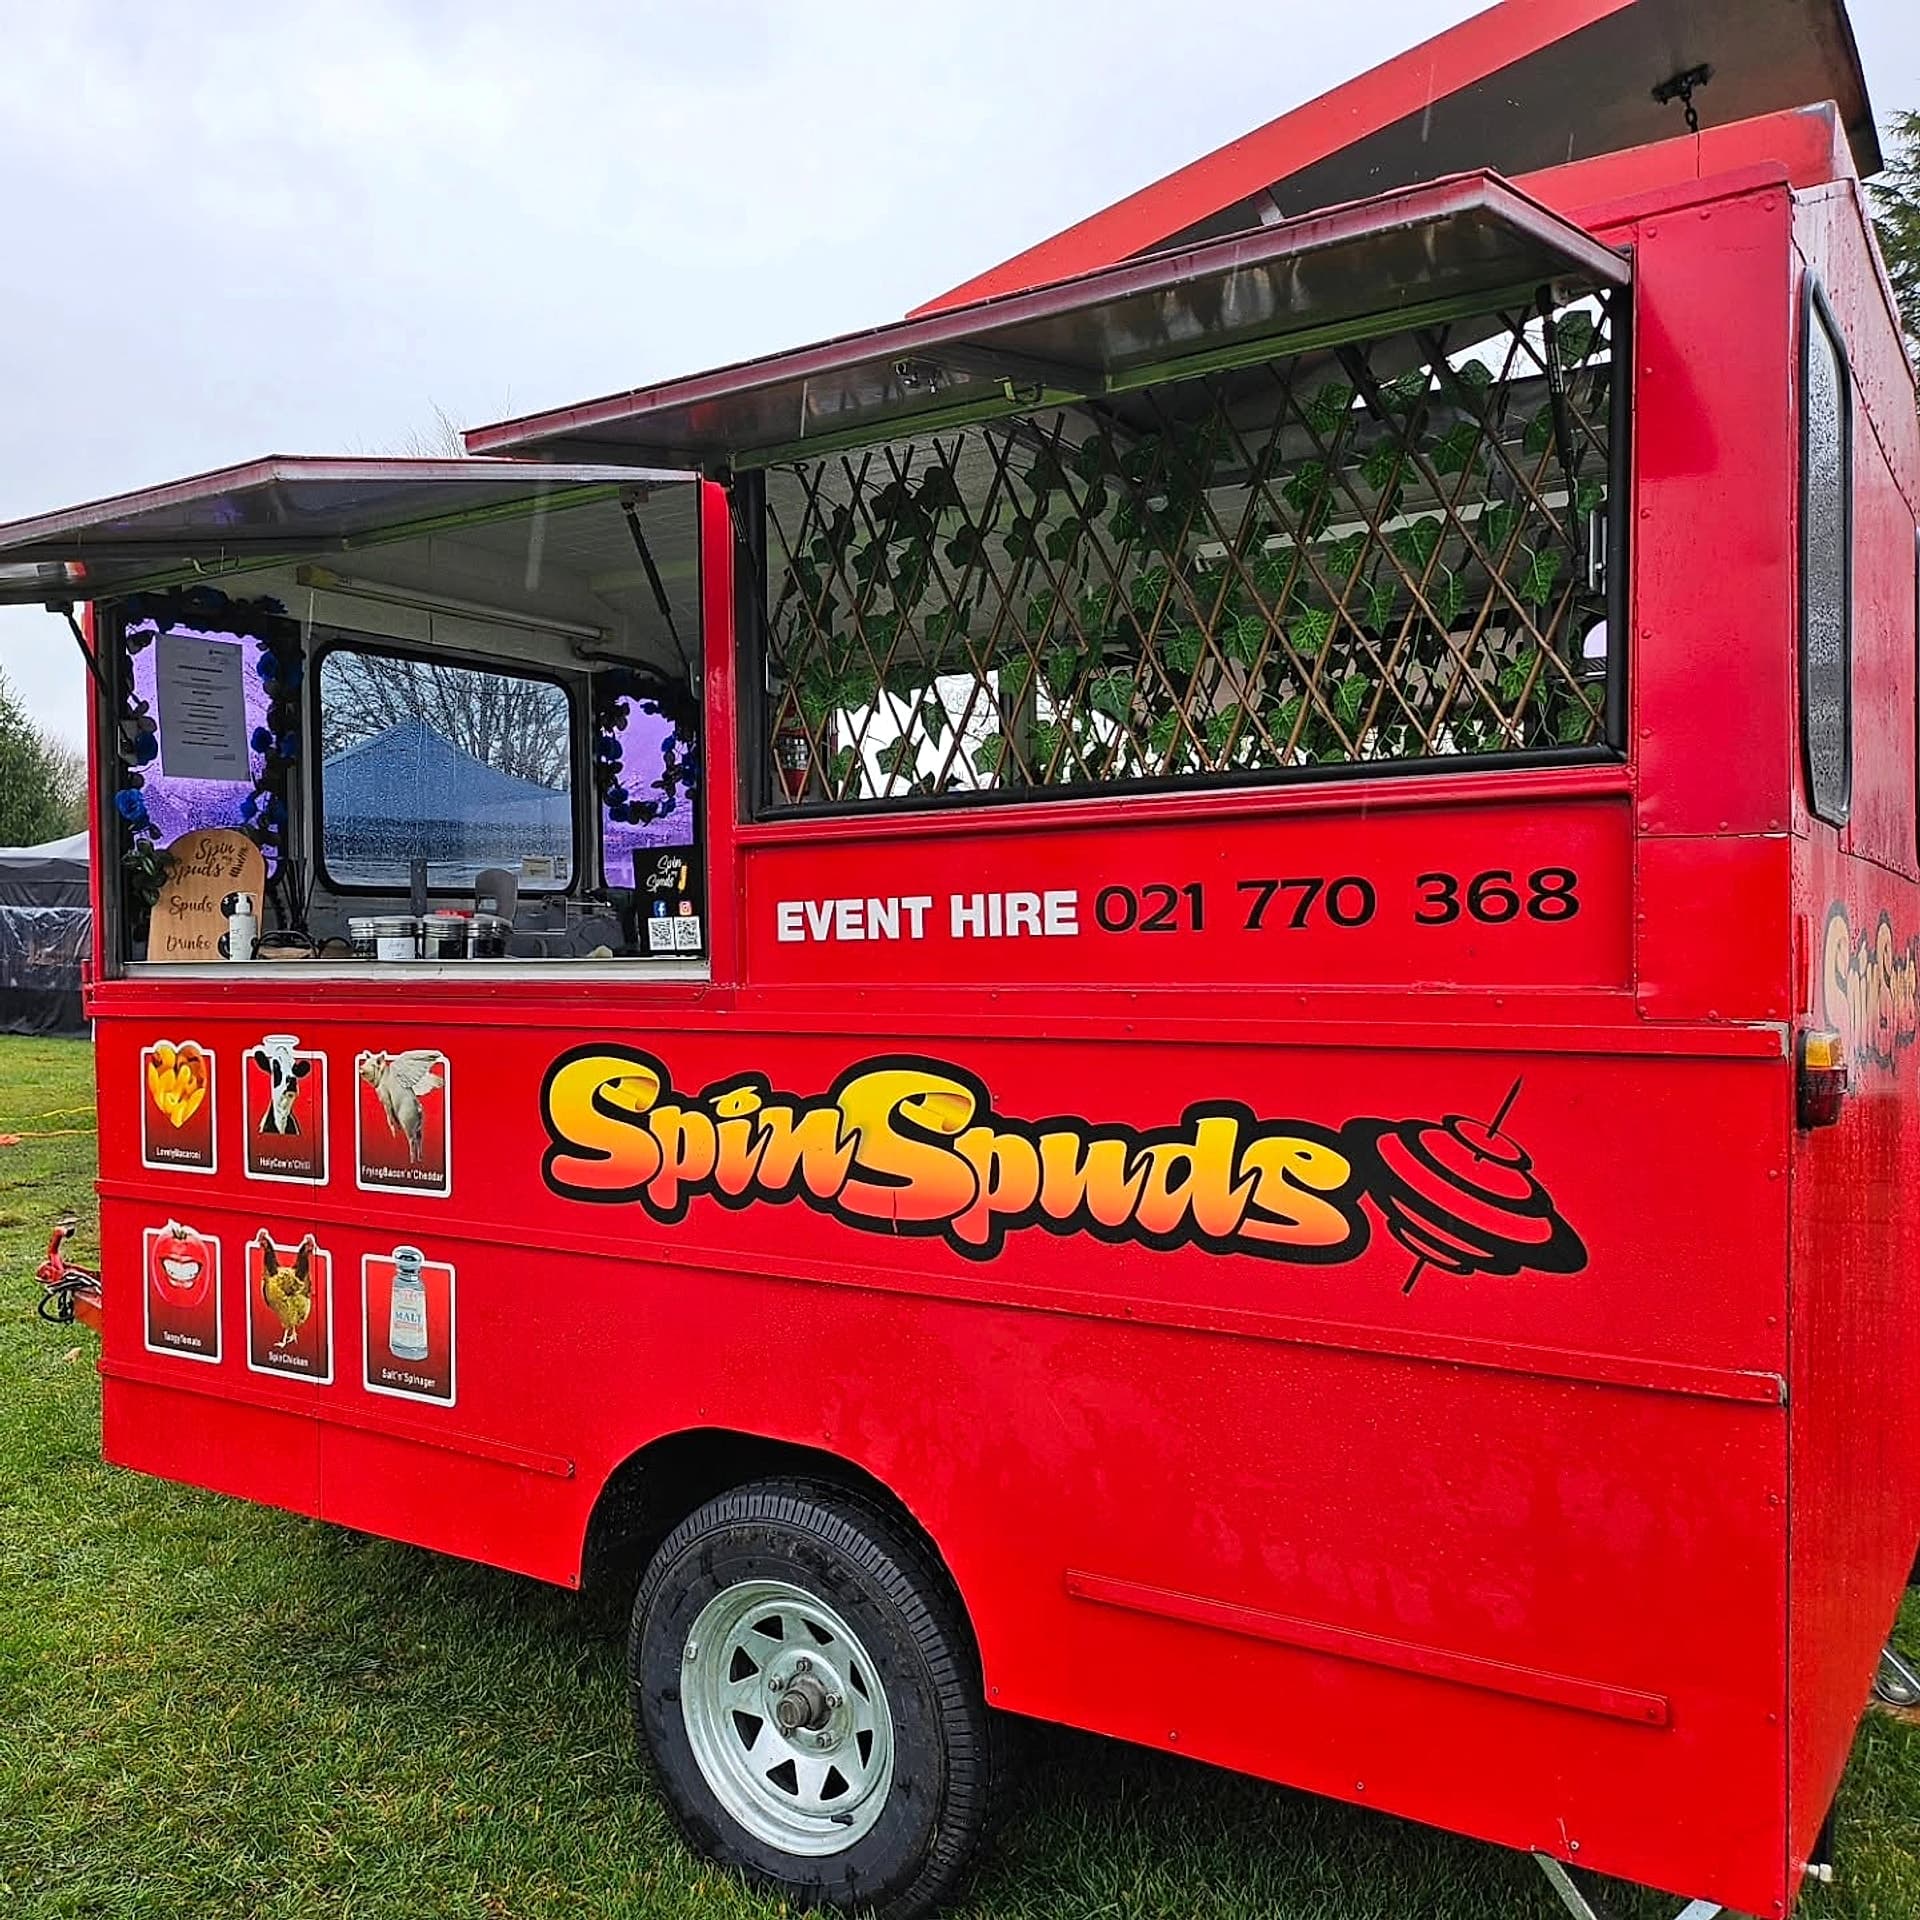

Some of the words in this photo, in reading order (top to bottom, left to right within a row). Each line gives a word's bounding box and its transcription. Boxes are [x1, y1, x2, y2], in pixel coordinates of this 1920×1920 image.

[195, 838, 235, 864] Spin
[657, 854, 682, 874] Spin
[169, 895, 213, 920] Spuds
[777, 896, 933, 943] EVENT
[950, 890, 1079, 940] HIRE
[1096, 883, 1203, 932] 021
[1237, 876, 1376, 930] 770
[1416, 867, 1580, 925] 368
[166, 934, 212, 952] Drinks
[546, 1054, 1353, 1247] SpinSpuds
